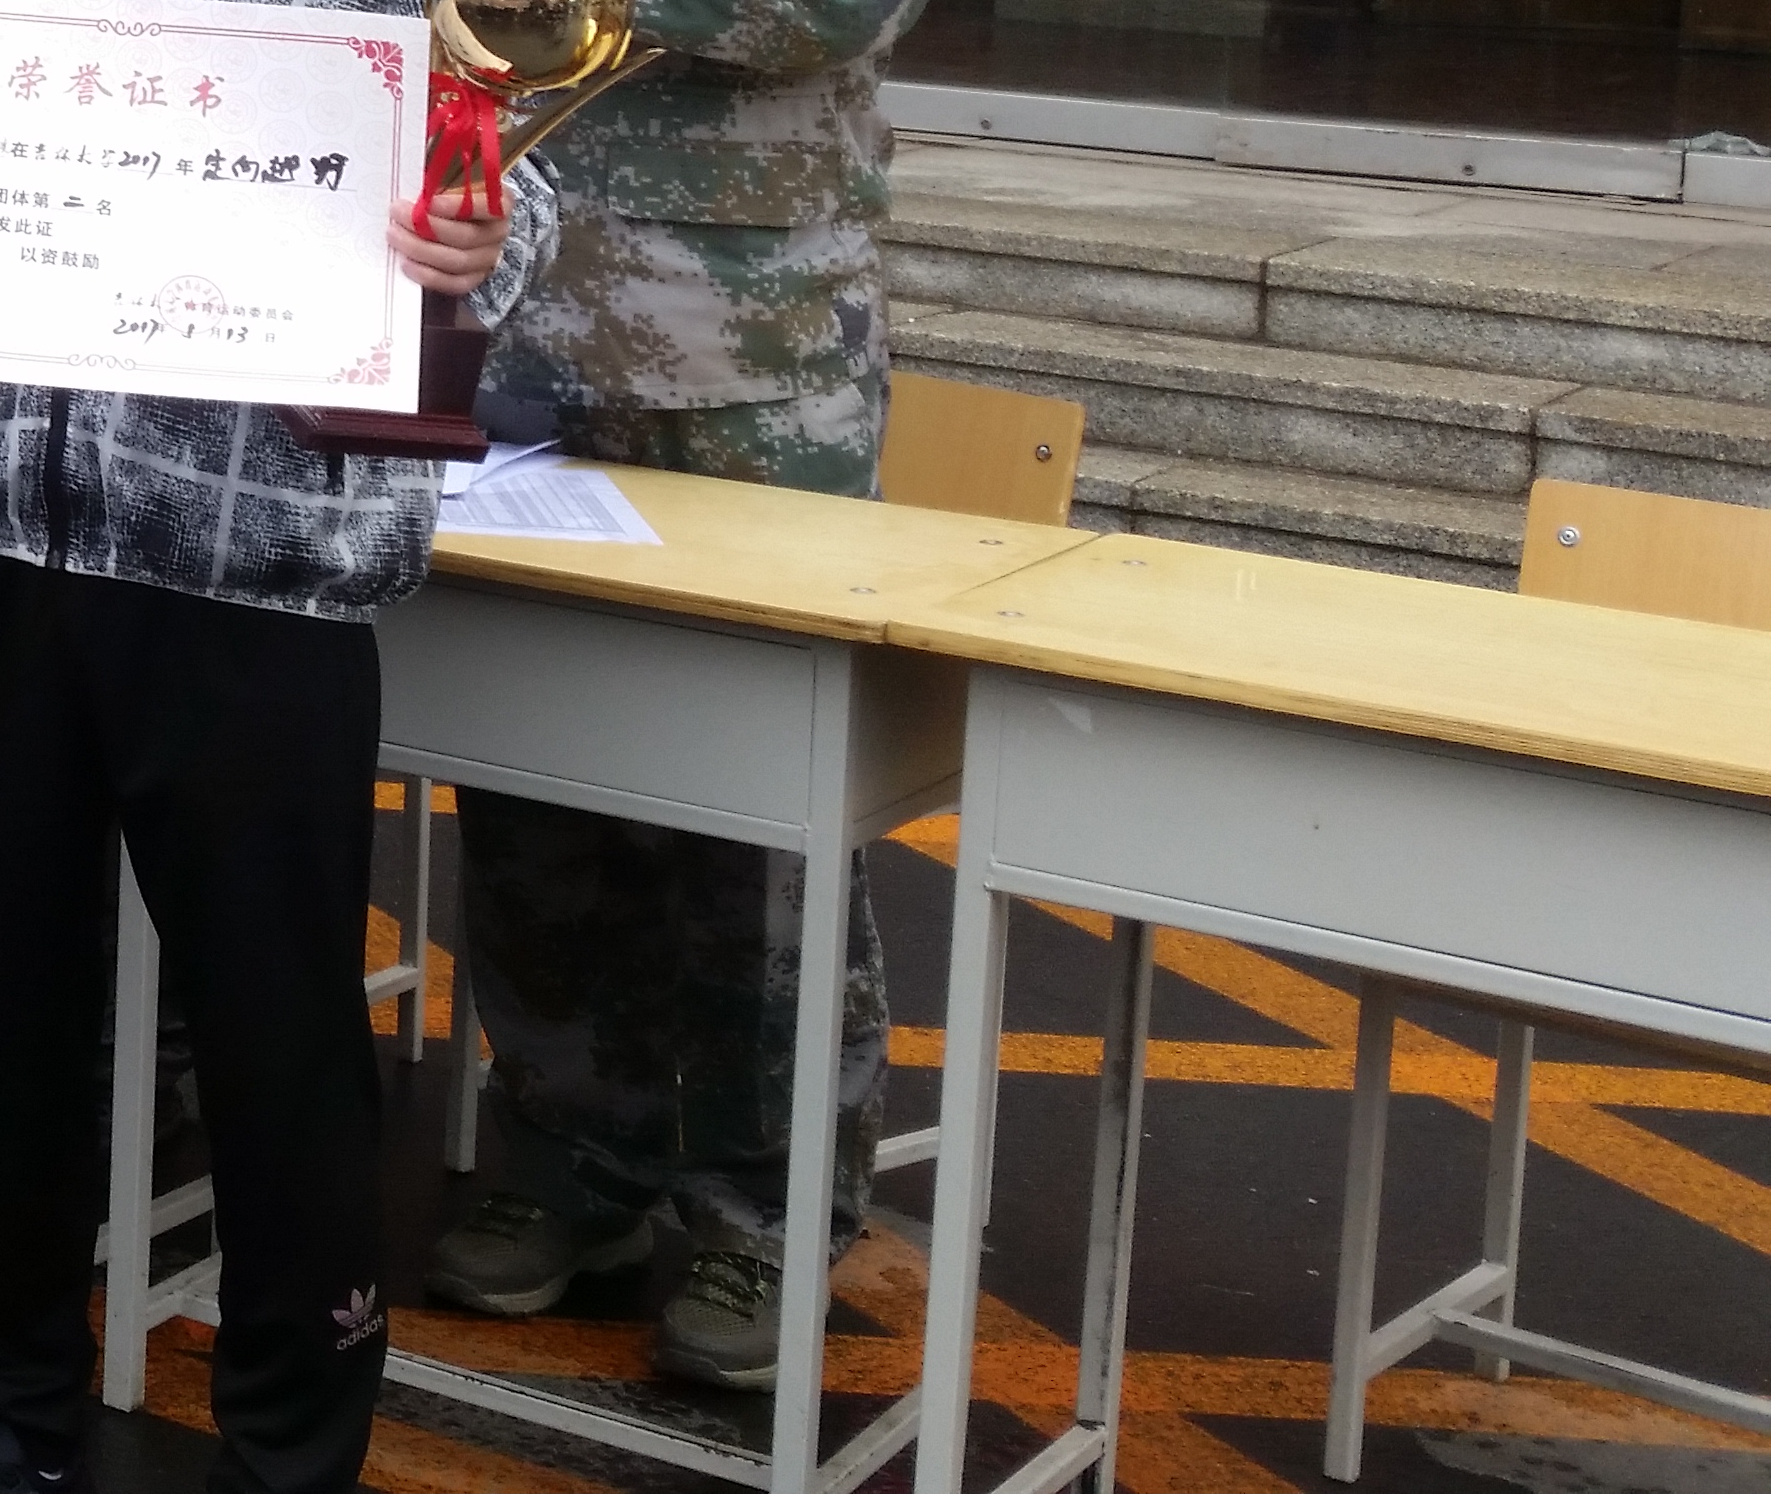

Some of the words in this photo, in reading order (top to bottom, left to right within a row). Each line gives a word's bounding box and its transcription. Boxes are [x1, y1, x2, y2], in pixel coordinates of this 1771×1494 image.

[8, 57, 226, 118] 荣誉证书
[20, 246, 100, 270] 以资鼓励
[335, 1313, 385, 1351] adidas
